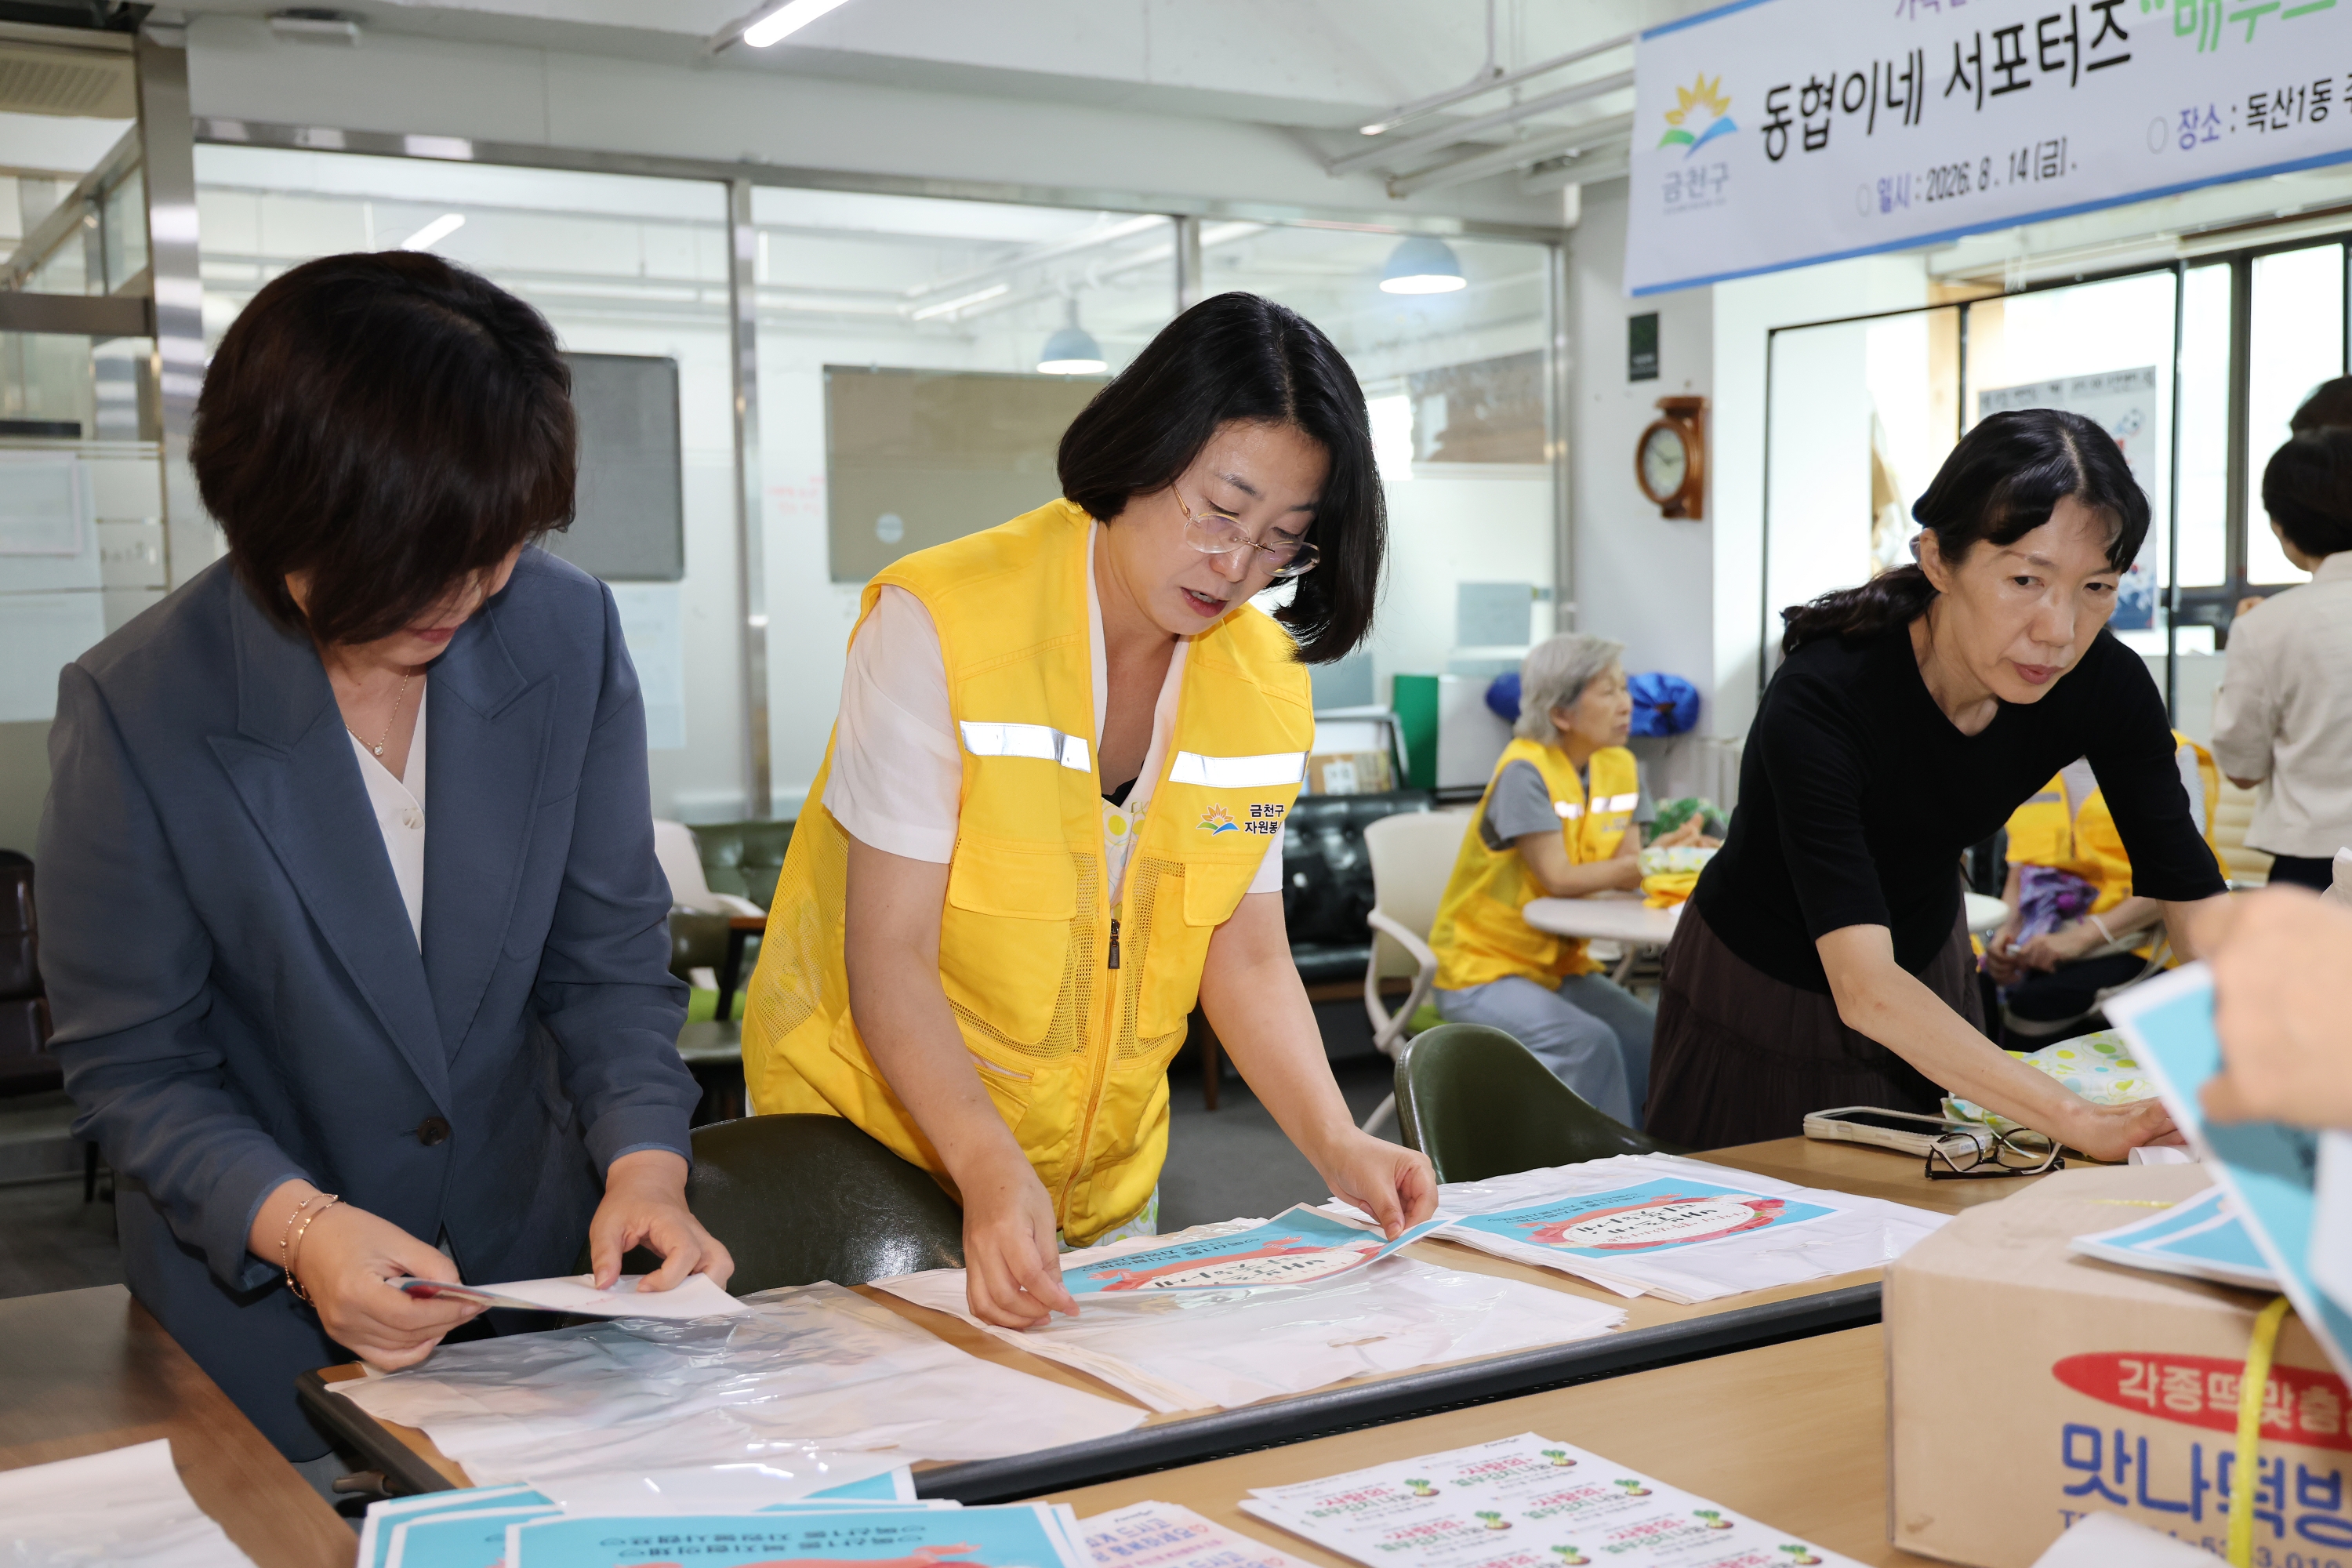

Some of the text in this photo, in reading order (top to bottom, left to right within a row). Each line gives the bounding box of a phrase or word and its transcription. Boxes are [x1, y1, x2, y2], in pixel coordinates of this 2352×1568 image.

[1761, 49, 1924, 162] 동협이네
[1944, 1, 2131, 111] 서포터즈
[2177, 103, 2221, 151] 장소
[2246, 78, 2333, 133] 독산1동
[1661, 162, 1729, 204] 금천구
[1877, 172, 1912, 215] 일시
[1244, 821, 1283, 834] 자원봉
[1250, 804, 1285, 818] 금천구
